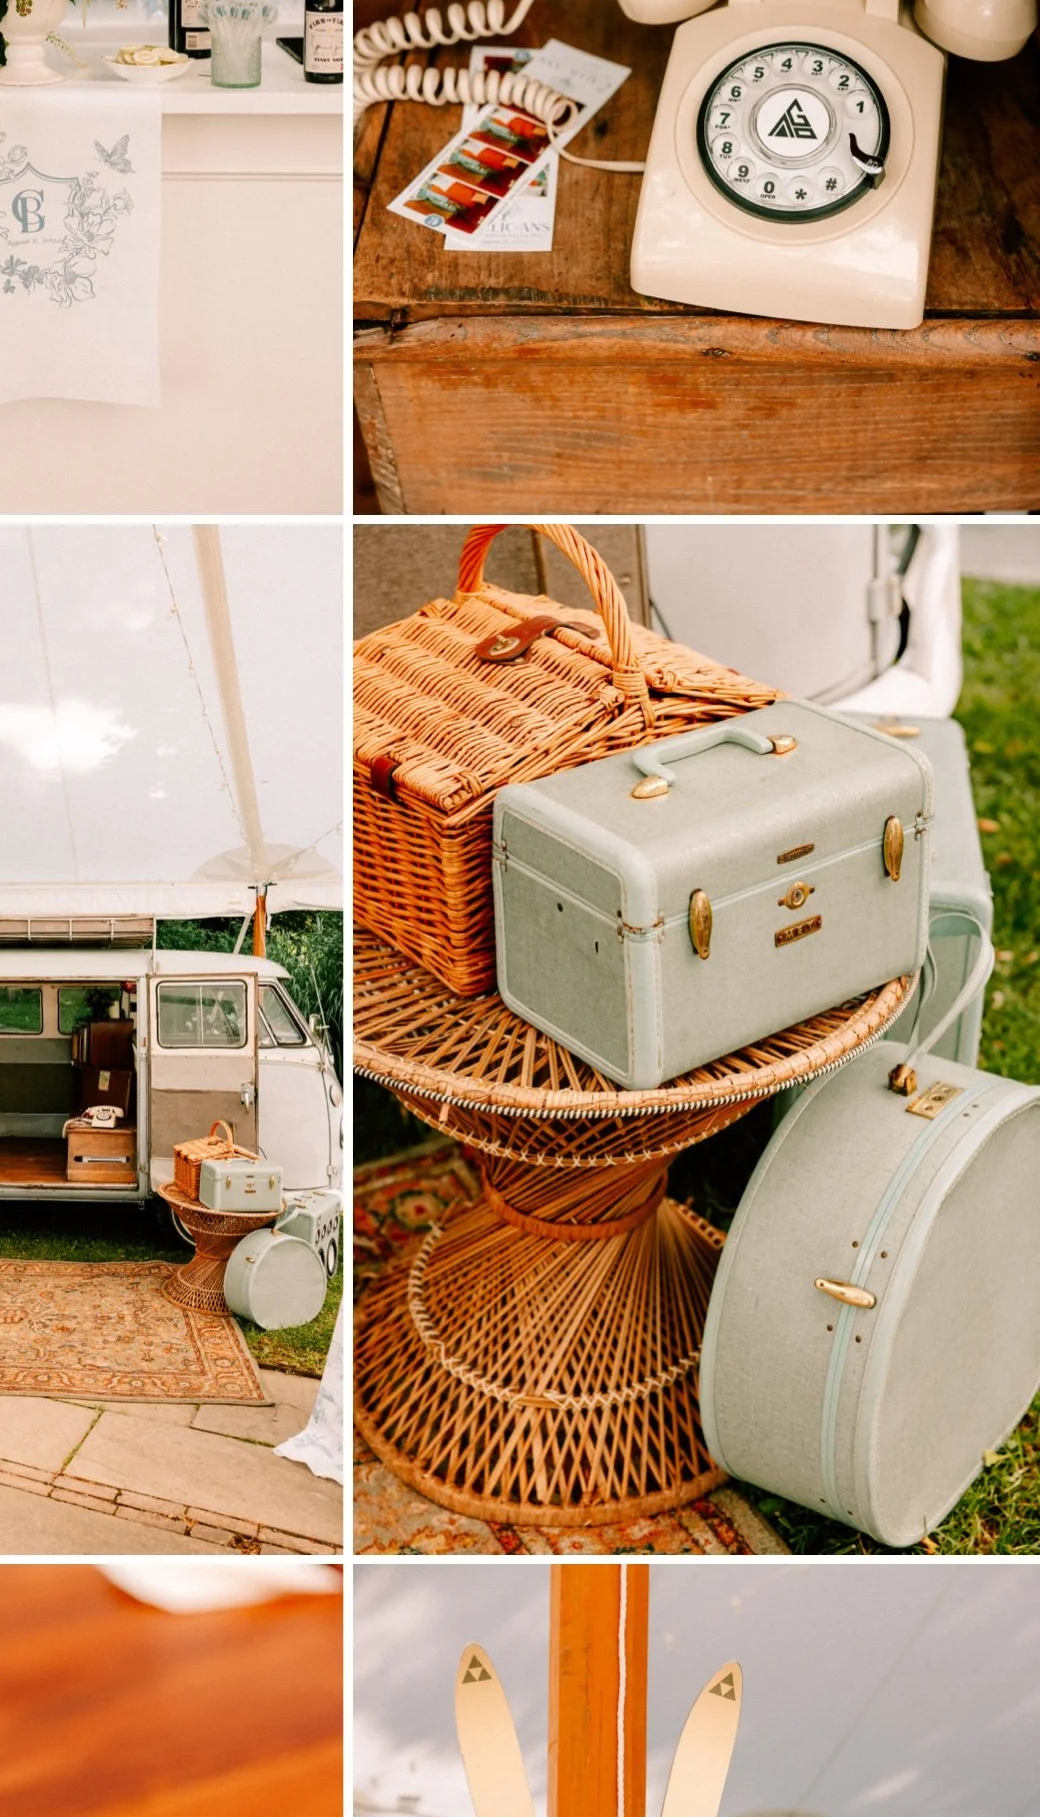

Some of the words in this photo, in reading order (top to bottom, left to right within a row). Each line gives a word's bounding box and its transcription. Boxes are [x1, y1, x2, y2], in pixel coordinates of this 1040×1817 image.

[781, 57, 793, 70] 4
[812, 60, 824, 72] 3
[753, 67, 764, 79] 5
[838, 75, 850, 87] 2
[730, 86, 742, 98] 6
[856, 101, 865, 113] 1
[719, 112, 730, 124] 7
[721, 141, 733, 154] 8
[738, 165, 749, 178] 9
[763, 181, 775, 193] 0
